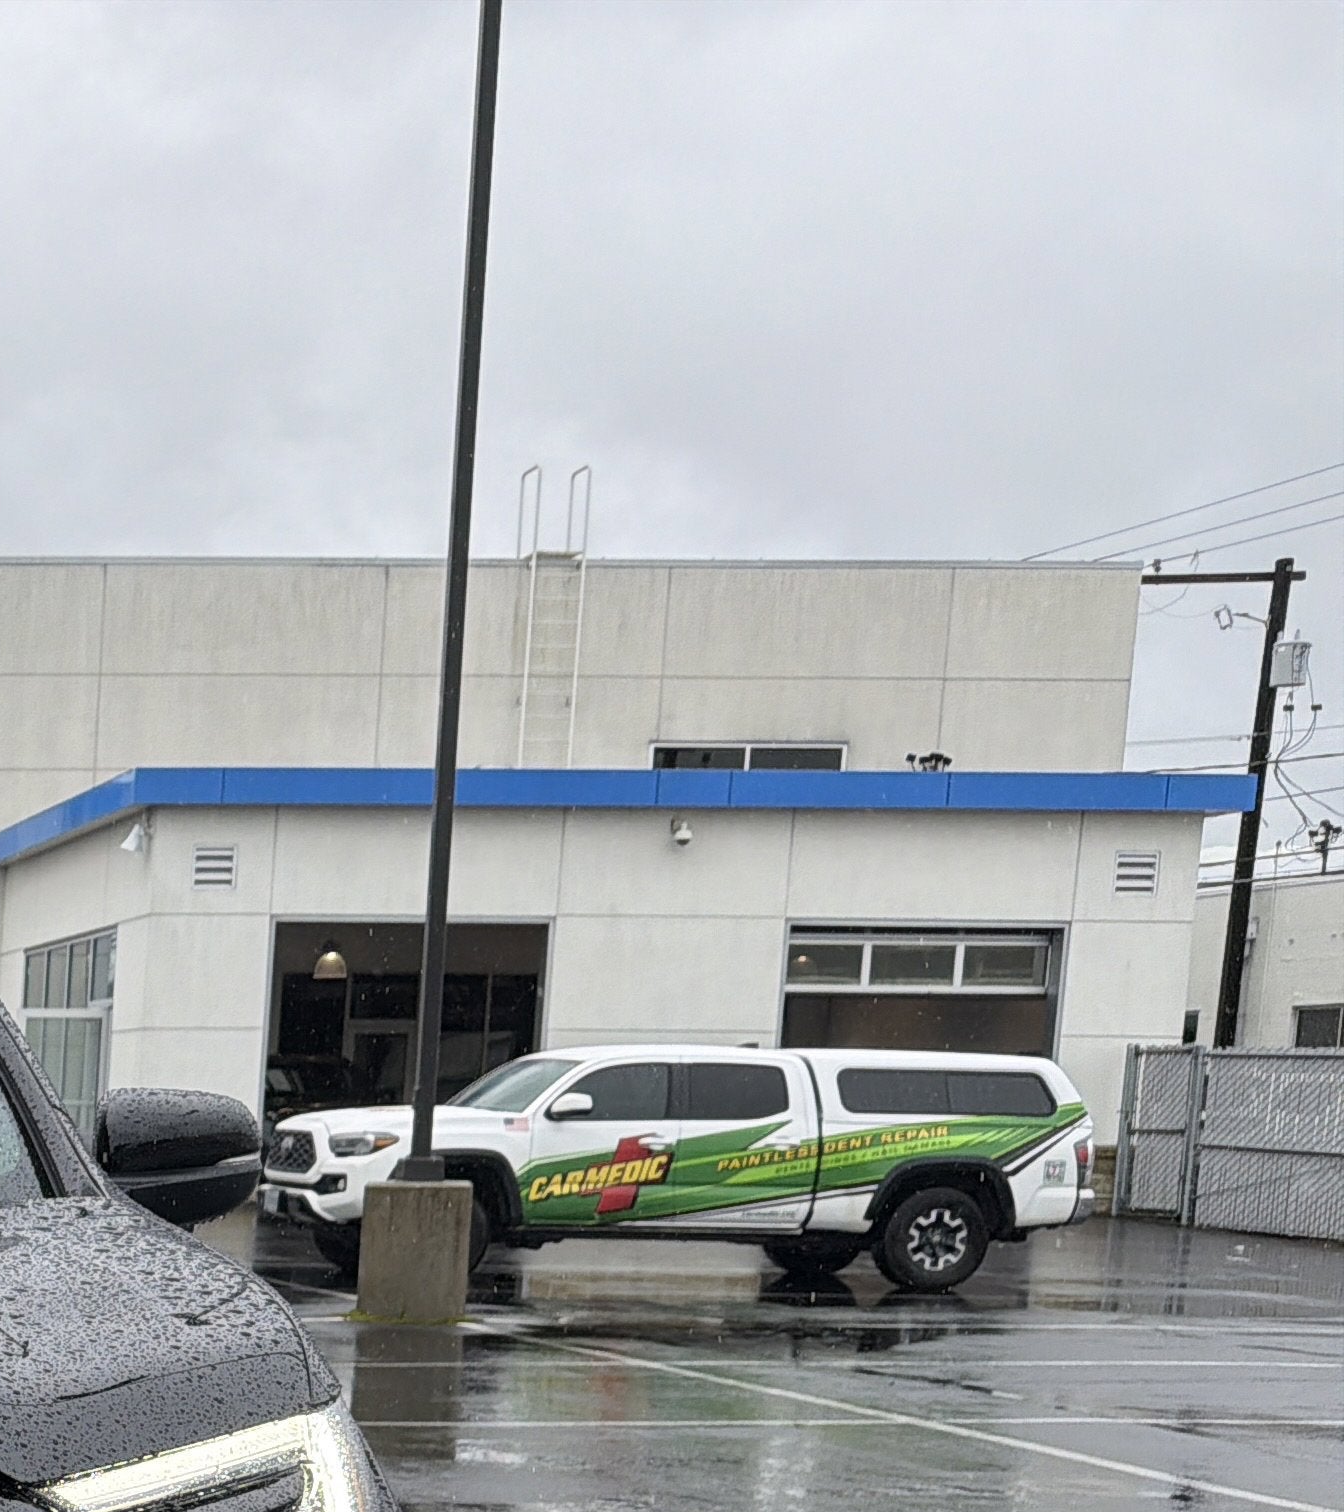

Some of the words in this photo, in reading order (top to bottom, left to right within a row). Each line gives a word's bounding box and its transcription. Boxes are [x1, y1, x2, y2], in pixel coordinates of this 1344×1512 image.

[823, 1136, 873, 1153] DENT
[880, 1126, 949, 1144] REPAIR
[528, 1154, 670, 1202] CARMEDIC
